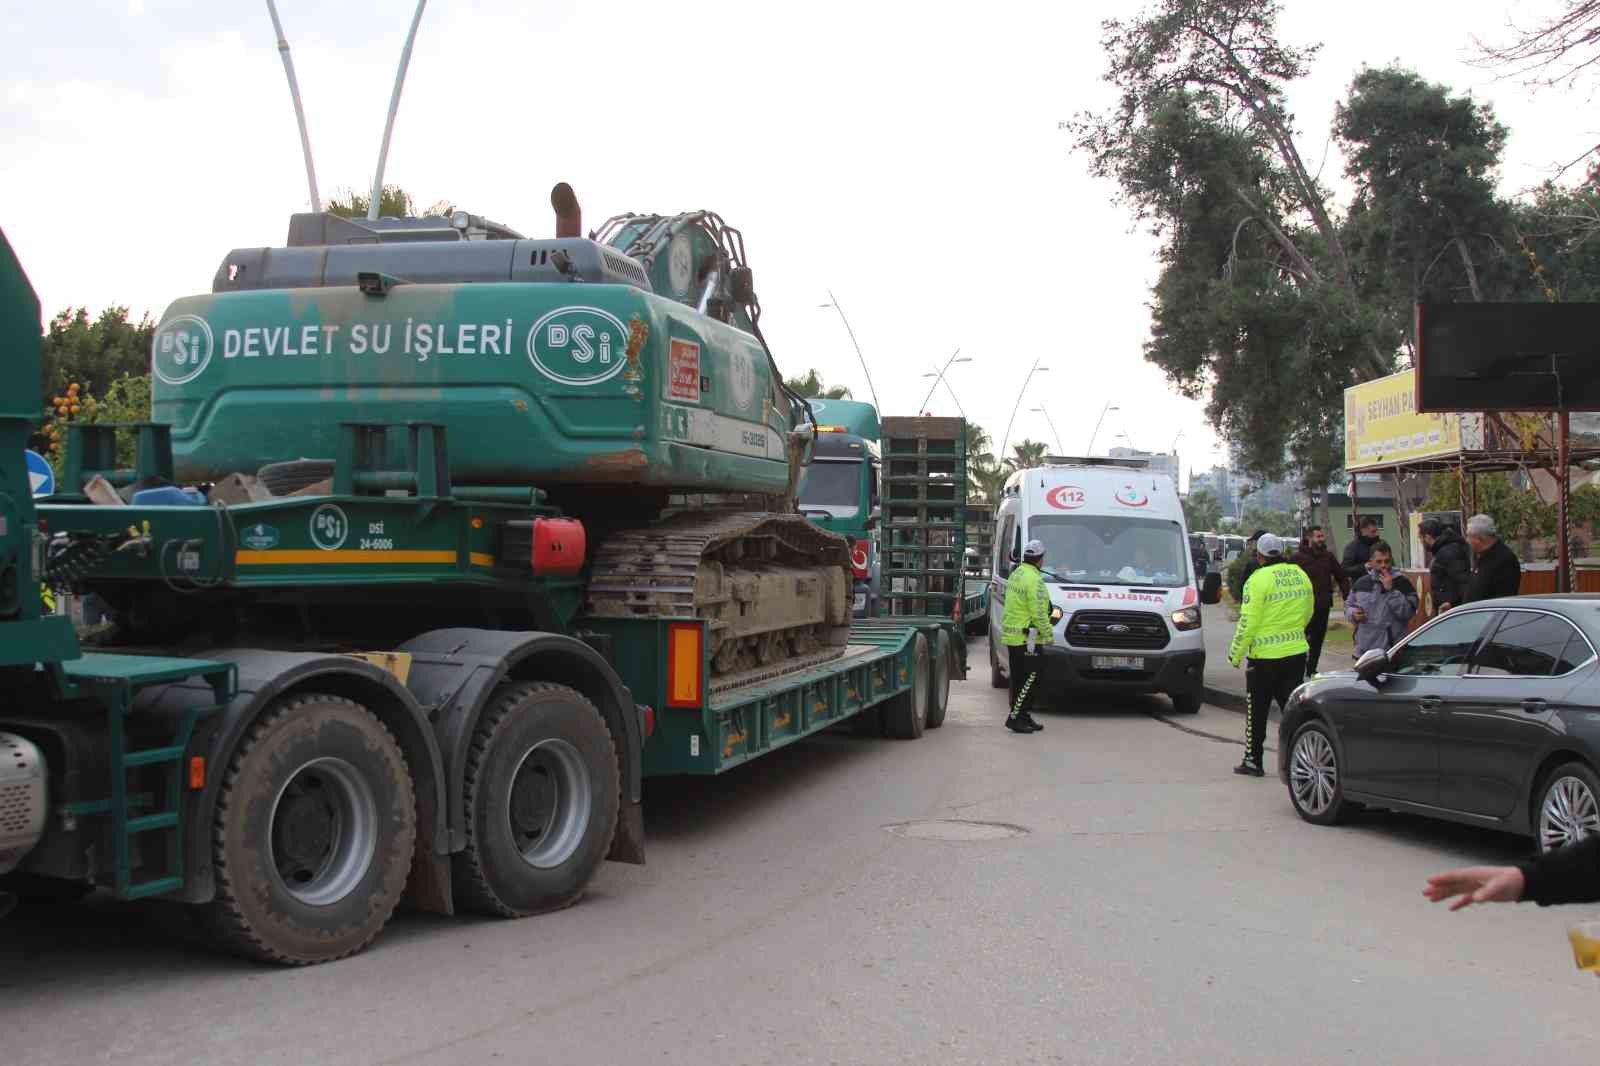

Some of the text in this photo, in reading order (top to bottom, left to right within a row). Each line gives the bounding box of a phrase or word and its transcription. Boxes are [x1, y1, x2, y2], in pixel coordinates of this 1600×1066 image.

[223, 317, 513, 362] DEVLET SU İŞLERİ
[1060, 491, 1085, 502] 112
